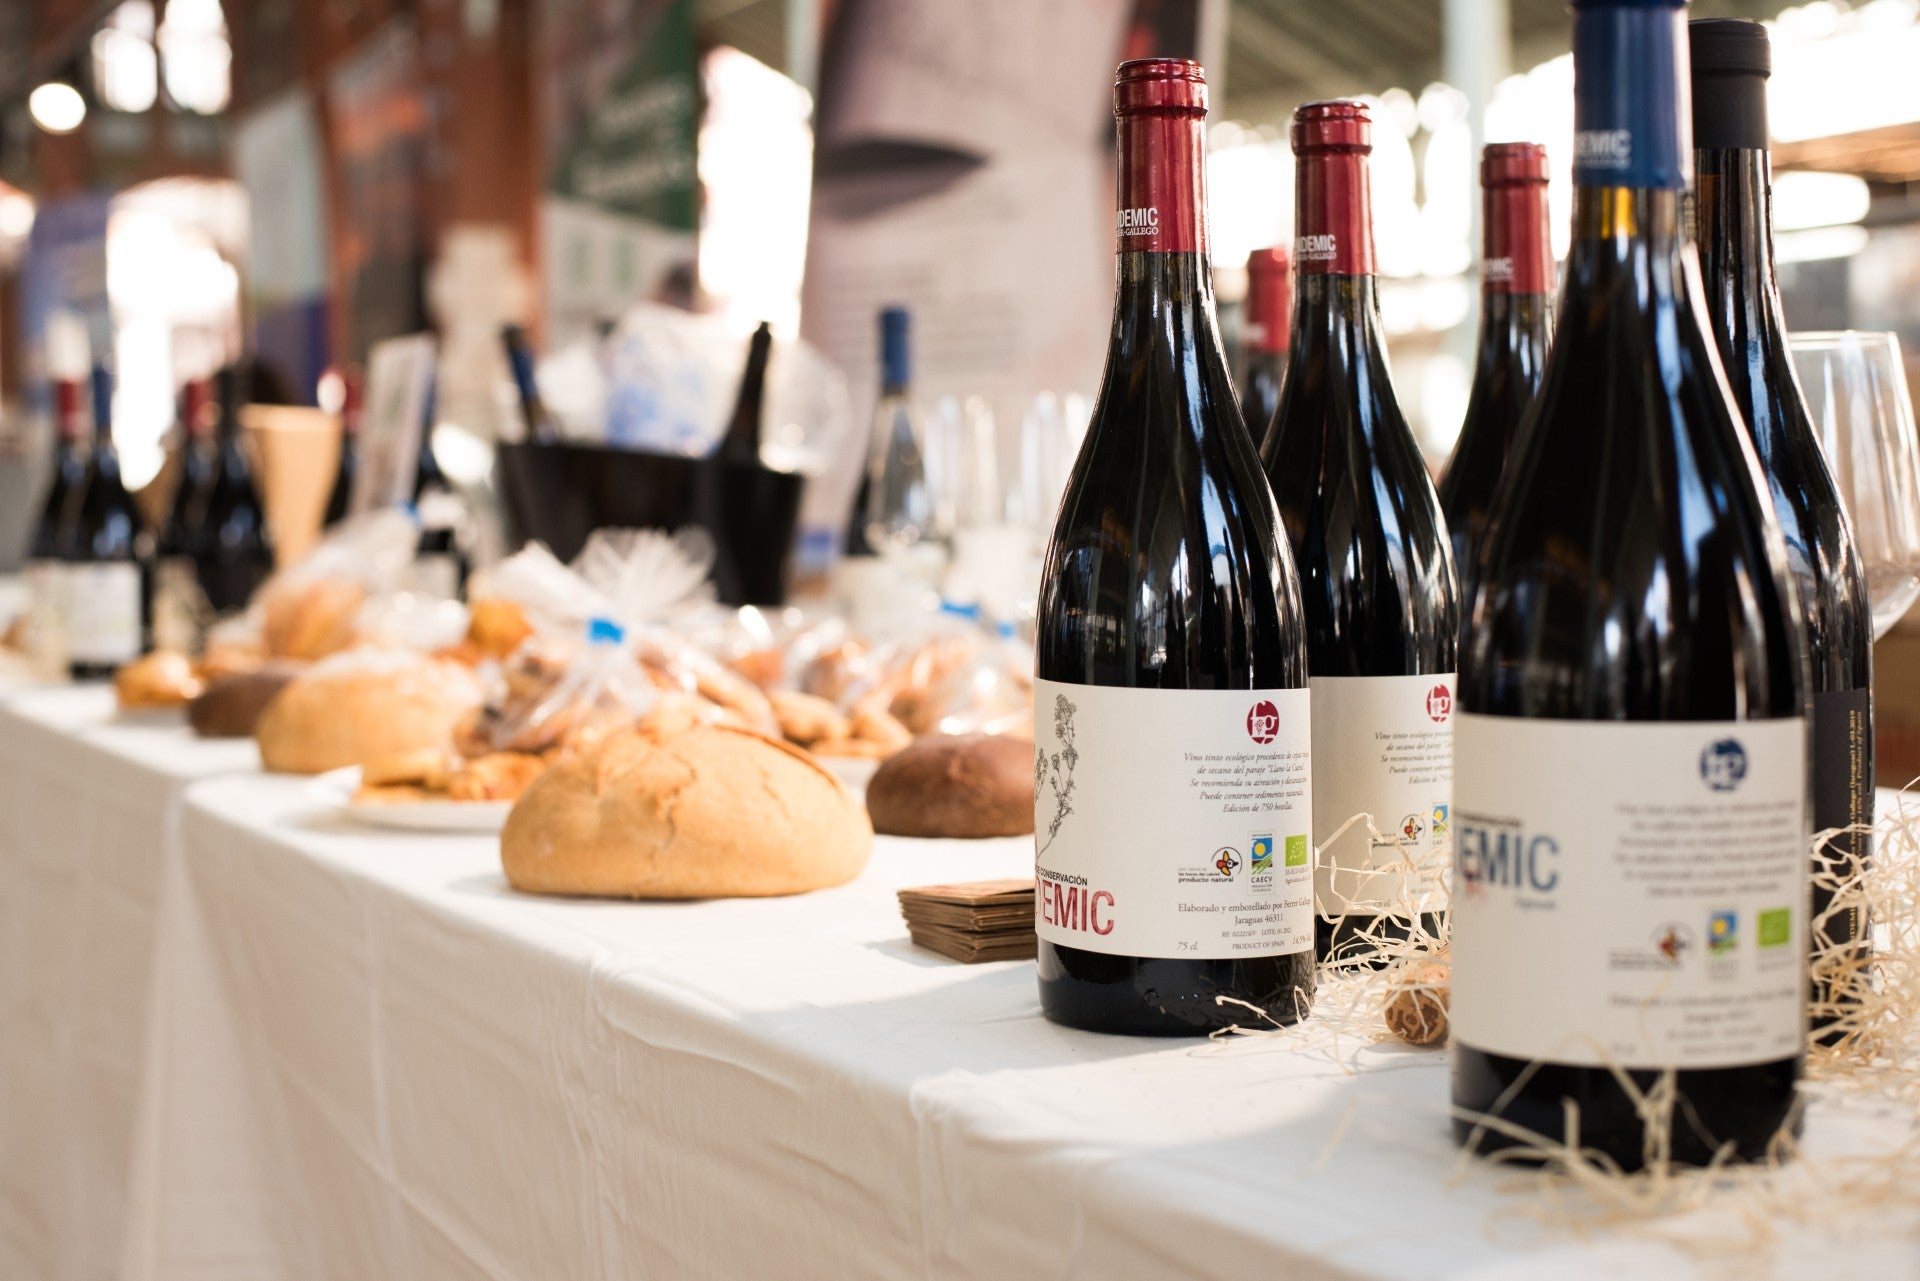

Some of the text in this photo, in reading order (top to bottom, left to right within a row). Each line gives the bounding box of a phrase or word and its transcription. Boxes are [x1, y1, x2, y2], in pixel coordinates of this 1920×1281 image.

[1375, 732, 1391, 740] Vino
[1184, 752, 1202, 760] Vino
[1205, 752, 1223, 760] tinto
[1225, 752, 1254, 763] ecológico
[1380, 754, 1388, 762] Se
[1390, 753, 1424, 762] recomienda
[1197, 766, 1206, 774] de
[1234, 765, 1243, 774] del
[1389, 765, 1408, 774] Puede
[1190, 778, 1199, 787] Se
[1200, 791, 1222, 800] Puede
[1223, 803, 1250, 812] Edición
[1252, 803, 1259, 812] de
[1261, 803, 1273, 812] 750
[1041, 868, 1087, 886] CONSERVACIÓN
[1178, 904, 1219, 912] Elaborado
[1221, 906, 1226, 914] y
[1228, 902, 1270, 912] embotellado
[1234, 915, 1263, 926] Jaraguas
[1177, 942, 1188, 951] 75
